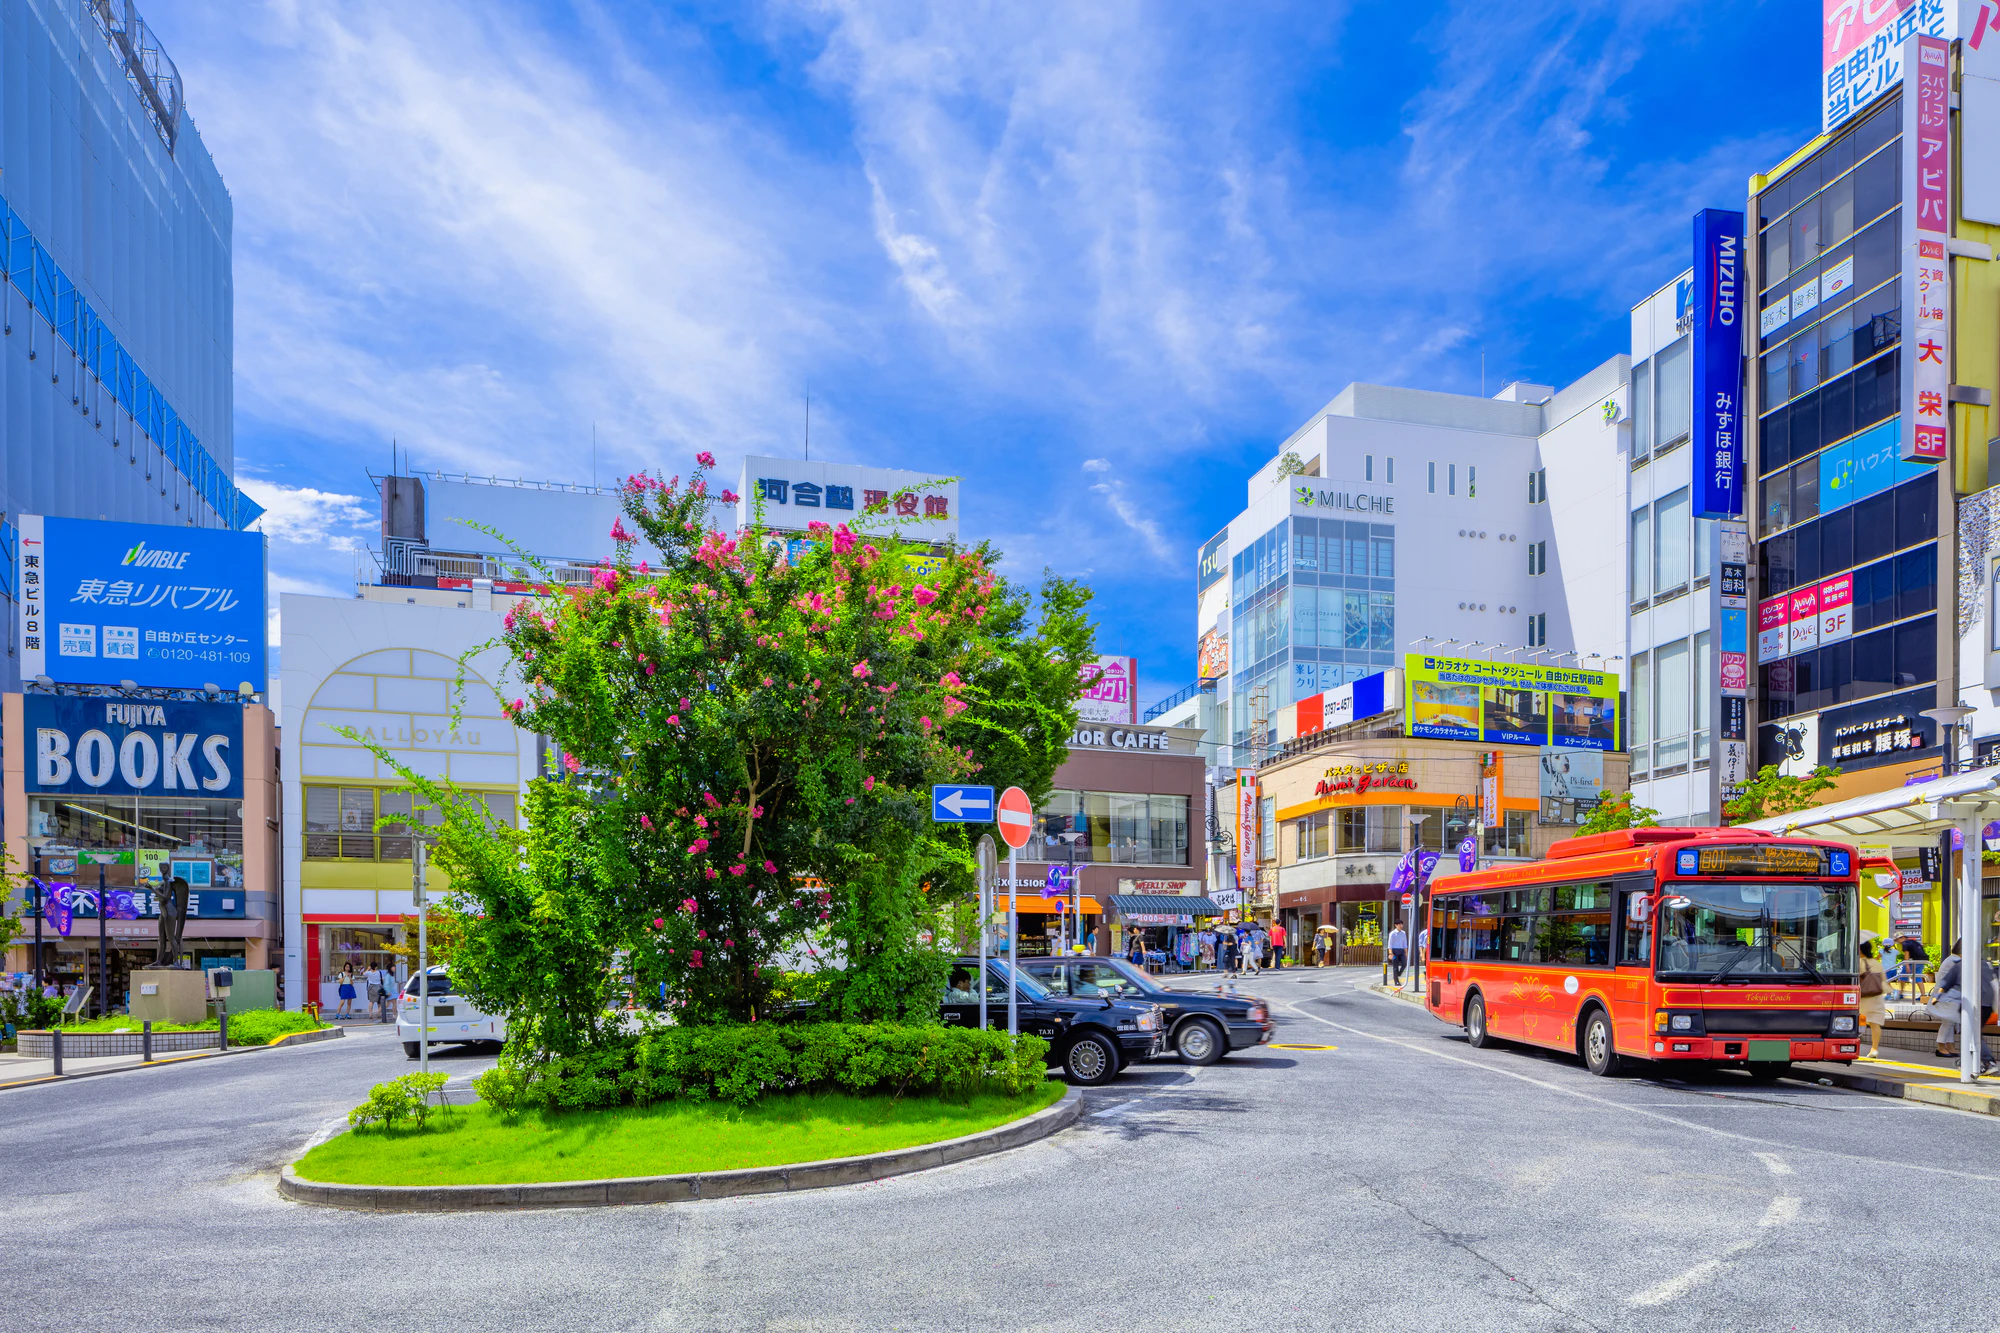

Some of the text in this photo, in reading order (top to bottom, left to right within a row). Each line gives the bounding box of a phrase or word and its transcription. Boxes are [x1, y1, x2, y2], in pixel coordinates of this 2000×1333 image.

[1921, 74, 1932, 126] スクール
[1933, 76, 1944, 127] パソコン
[1921, 137, 1943, 221] アビバ
[1719, 235, 1736, 326] MIZUHO
[1918, 267, 1930, 319] スクール
[1932, 269, 1944, 321] 資格
[1917, 338, 1943, 417] 大栄
[1715, 392, 1732, 490] みずほ銀行
[1917, 432, 1943, 452] 3F
[758, 477, 949, 520] 河合塾 現役館
[1320, 489, 1395, 514] MILCHE
[69, 578, 240, 612] 東急リバブル
[1721, 578, 1745, 593] 歯科
[24, 554, 40, 651] 東急ビル8階
[1762, 602, 1784, 616] パソコン
[1762, 612, 1784, 625] スクール
[1825, 613, 1847, 634] 3F
[63, 640, 92, 653] 売買
[144, 629, 249, 646] 自由が丘センター
[106, 641, 135, 656] 賃貸
[161, 648, 250, 664] 0120-481-109
[1722, 653, 1746, 664] パソコン
[1762, 643, 1784, 655] スクール
[1436, 659, 1604, 686] カラオケ コート・ダジュール 自由が丘駅前店
[1722, 677, 1745, 688] アビバ
[1296, 678, 1352, 690] クリニッ
[106, 703, 167, 729] FUJIYA
[343, 725, 481, 746] DALLOYAU
[1111, 730, 1169, 750] CAFFÉ
[1501, 732, 1531, 742] VIPルーム
[36, 727, 231, 792] BOOKS
[1323, 761, 1410, 778] パスタとピザの店
[1314, 776, 1355, 796] Miami
[144, 853, 159, 861] 100
[994, 878, 1046, 888] EXLSIOR
[1135, 881, 1187, 890] WEEKLY SHOP
[1745, 992, 1791, 1005] Tokyu Coach
